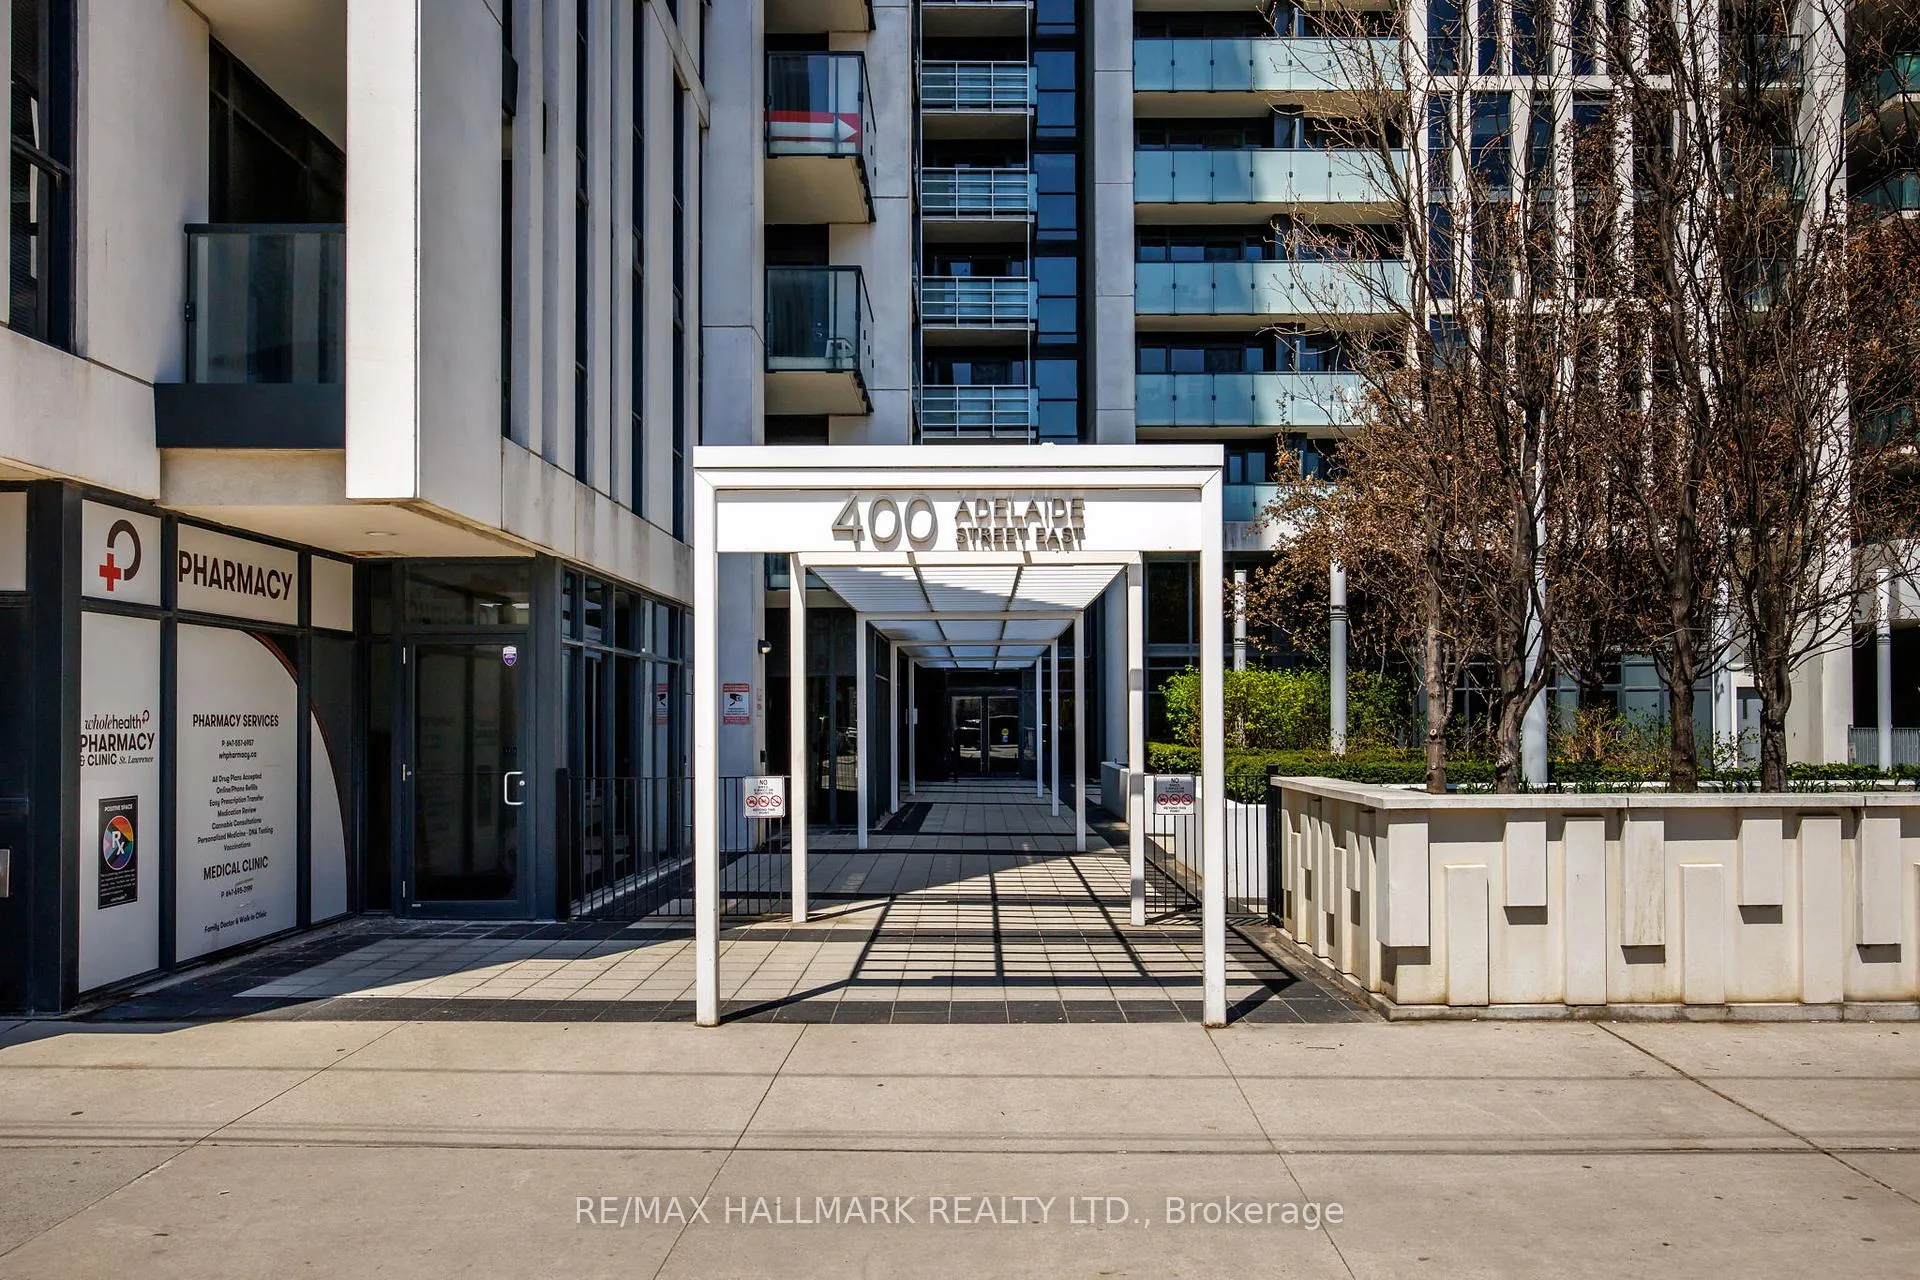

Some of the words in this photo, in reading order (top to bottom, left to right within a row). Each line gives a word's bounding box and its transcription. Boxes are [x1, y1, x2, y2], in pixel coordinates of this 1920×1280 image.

[831, 494, 939, 552] 400
[954, 497, 1086, 528] ADELAIDE
[955, 527, 1031, 551] STREET
[1035, 527, 1087, 551] EAST
[178, 550, 293, 601] PHARMACY
[85, 714, 142, 730] wholehealth
[192, 714, 241, 727] PHARMACY
[242, 714, 279, 727] SERVICES
[80, 732, 155, 753] PHARMACY
[87, 753, 117, 766] CLINIC
[203, 862, 240, 880] MEDICAL
[242, 856, 268, 872] CLINIC
